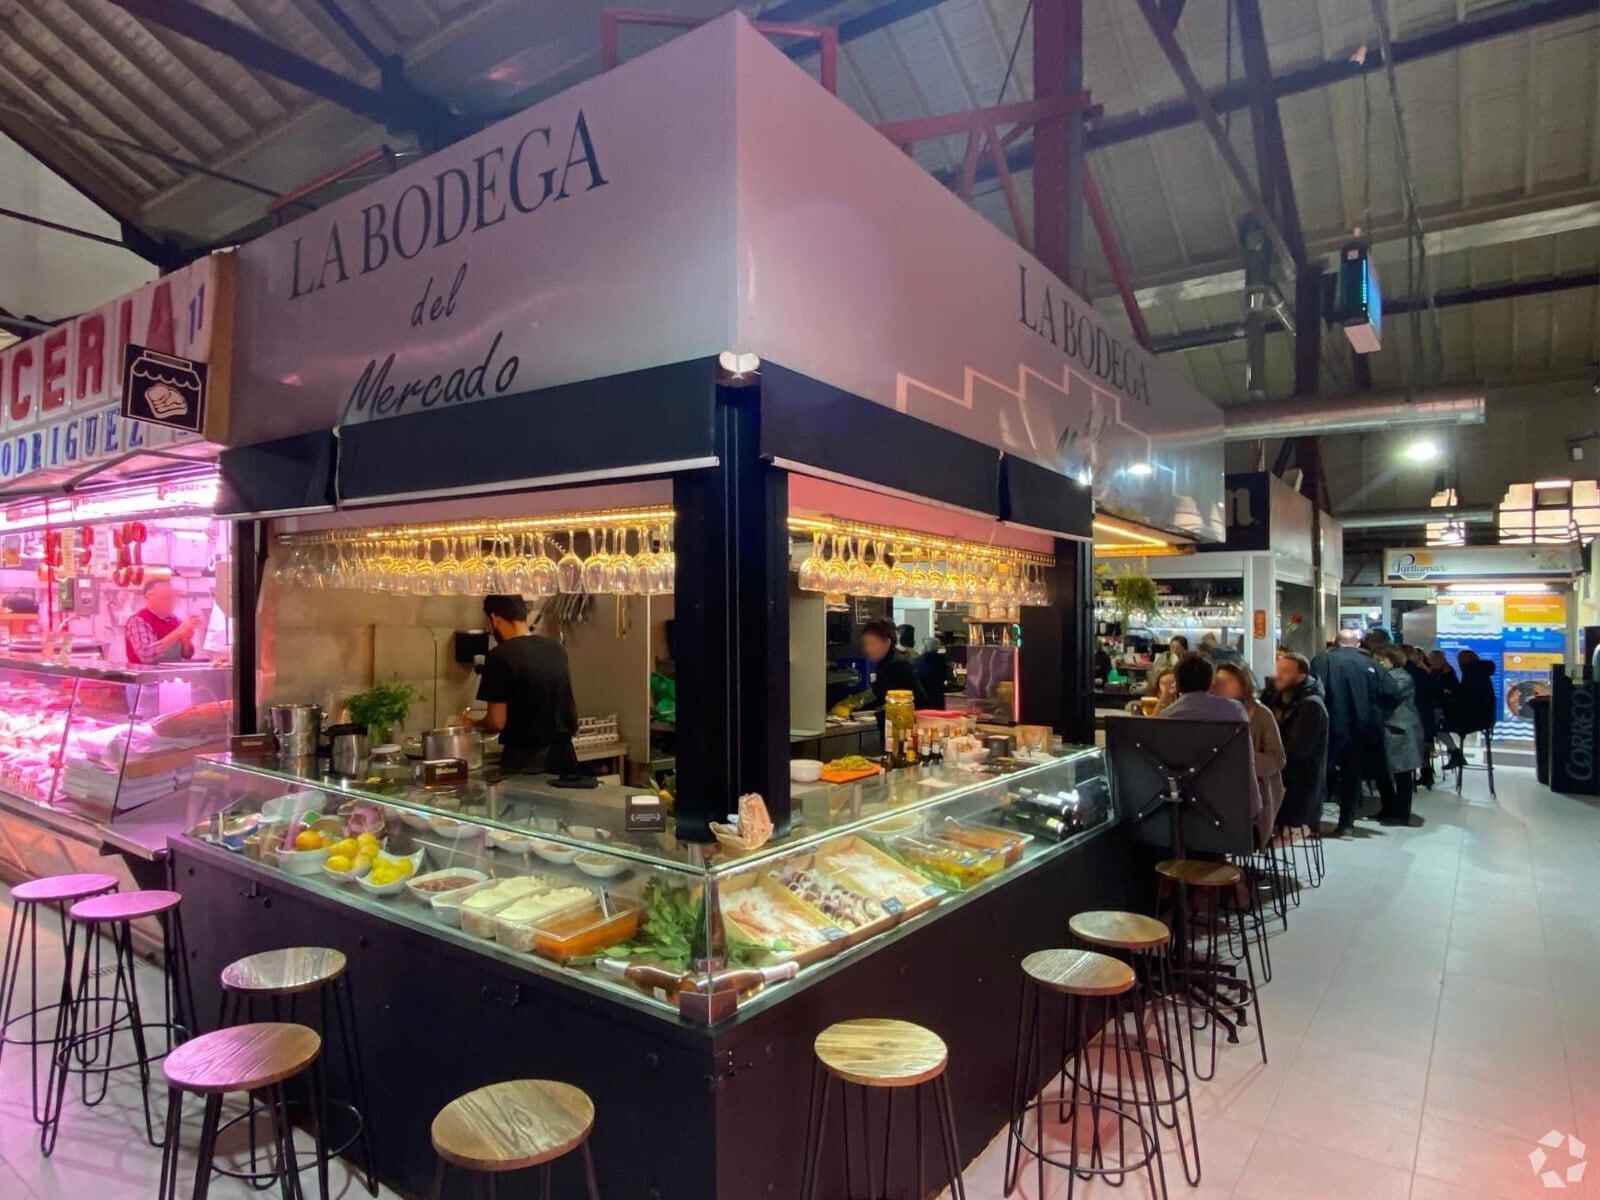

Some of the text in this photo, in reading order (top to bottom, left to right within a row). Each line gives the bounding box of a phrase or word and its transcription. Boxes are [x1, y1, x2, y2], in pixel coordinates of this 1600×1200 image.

[288, 108, 609, 300] LA BODEGA
[410, 262, 468, 328] del
[1018, 264, 1150, 406] LA BODEGA
[0, 281, 176, 426] CERIA
[338, 331, 520, 419] Mercado
[0, 405, 144, 477] ODRIGUEZ
